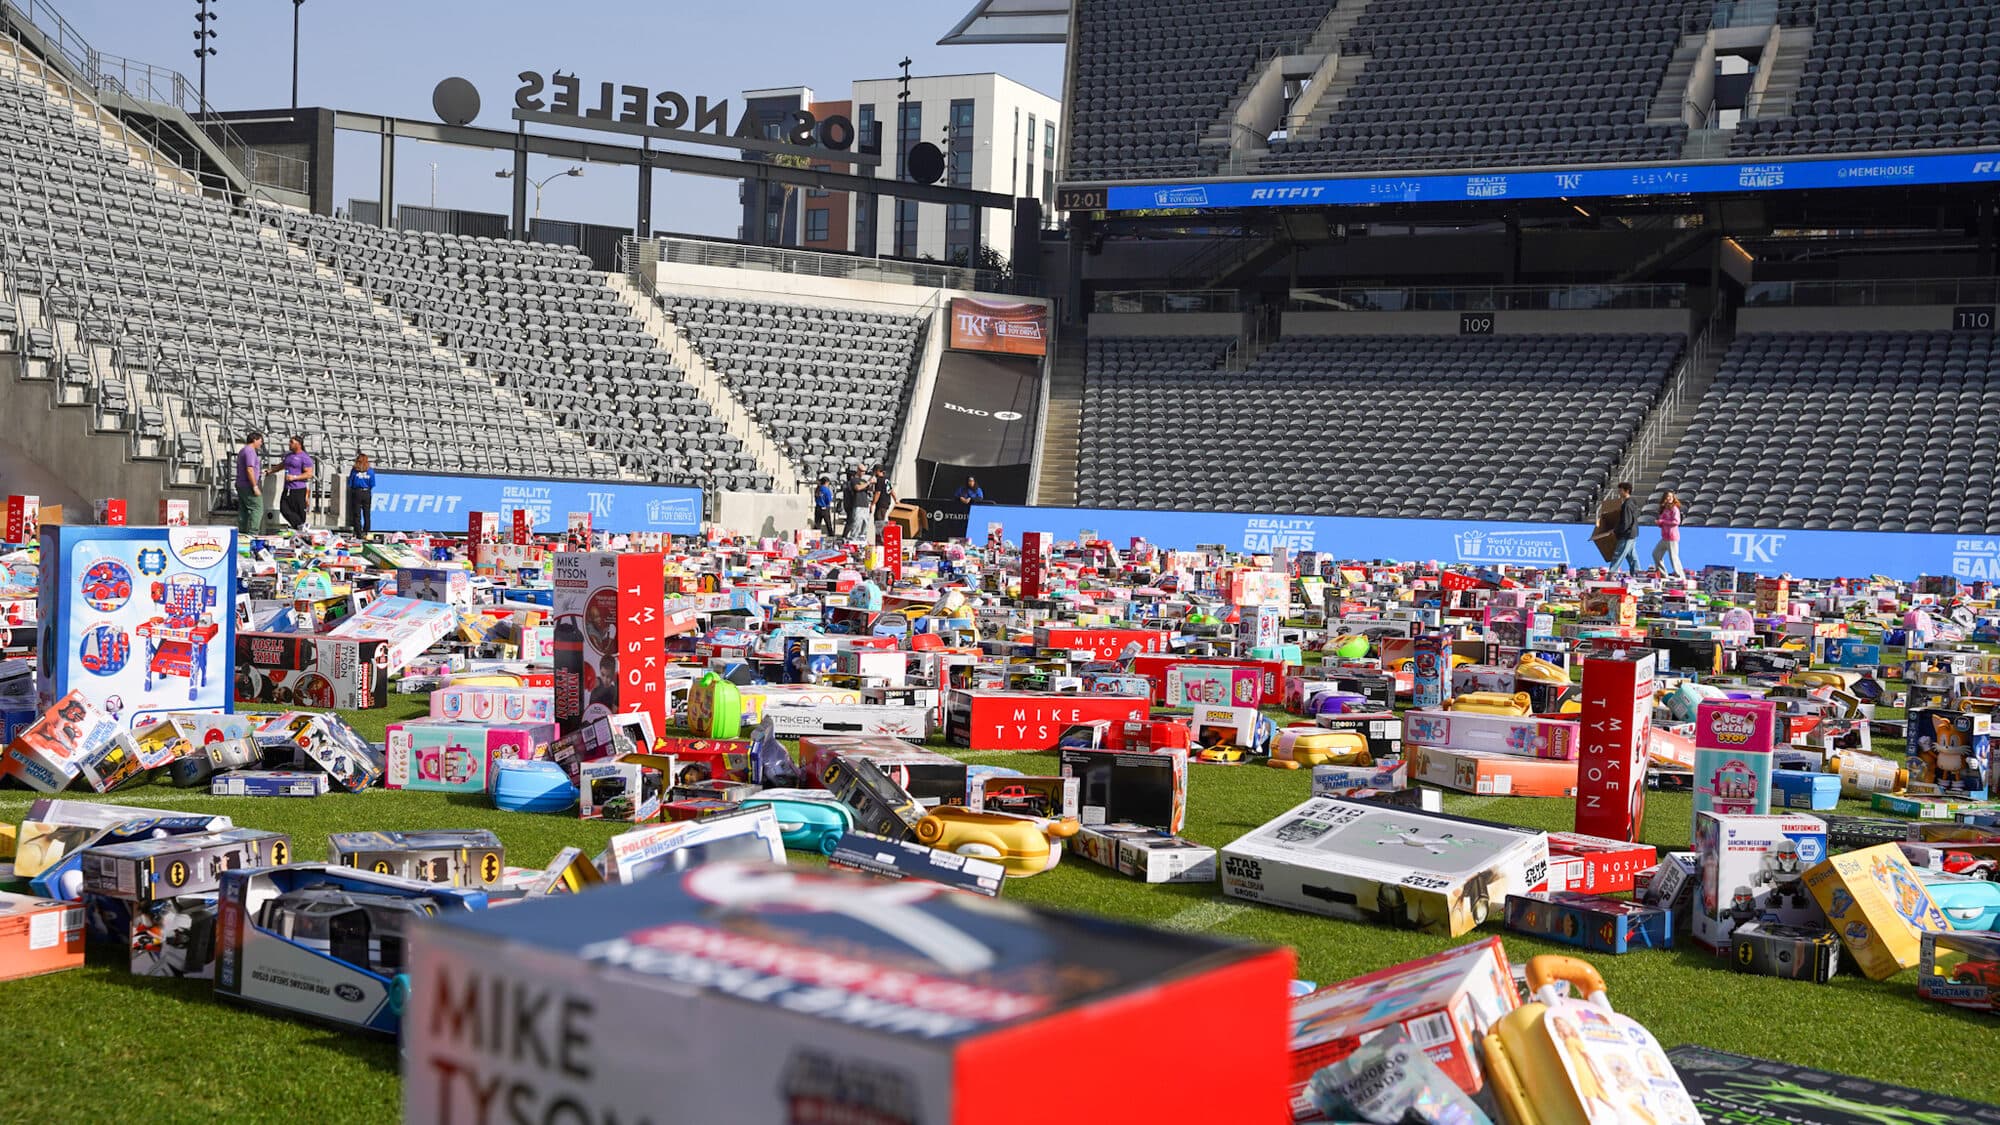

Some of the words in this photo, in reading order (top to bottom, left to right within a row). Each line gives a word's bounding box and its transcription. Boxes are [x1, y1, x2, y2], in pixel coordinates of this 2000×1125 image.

[1740, 165, 1783, 173] REALITY
[1849, 166, 1916, 177] MEMEHOUSE
[1467, 176, 1506, 184] REALITY
[1555, 174, 1583, 189] TKF
[1739, 175, 1784, 187] GAMES
[1252, 187, 1325, 199] RITFIT
[1467, 185, 1506, 196] GAMES
[1063, 192, 1101, 208] 12:01
[957, 314, 990, 336] TKF
[1463, 319, 1491, 332] 109
[1960, 313, 1990, 328] 110
[944, 402, 989, 417] BMO
[503, 486, 550, 499] REALITY
[371, 493, 462, 513] RITFIT
[588, 492, 616, 517] TKF
[661, 512, 673, 521] TOY
[674, 511, 693, 521] DRIVE
[1248, 519, 1314, 530] REALITY
[1244, 533, 1314, 553] GAMES
[1726, 533, 1787, 562] TKF
[1486, 545, 1516, 557] TOY
[1516, 546, 1562, 558] DRIVE
[557, 557, 580, 568] MIKE
[556, 569, 587, 579] TYSON
[251, 639, 285, 651] TYSON
[1075, 637, 1118, 647] MIKE
[628, 585, 642, 713] TYSON
[644, 607, 656, 692] MIKE
[341, 646, 349, 678] TYSON
[348, 645, 357, 670] MIKE
[1013, 709, 1081, 721] MIKE
[1207, 711, 1233, 719] SONIC
[995, 725, 1048, 739] TYS
[1713, 721, 1755, 735] CREAM
[1554, 727, 1562, 757] QUEEN
[1718, 733, 1747, 742] STOP
[1586, 698, 1606, 808] TYSON
[1606, 717, 1622, 790] MIKE
[1315, 773, 1348, 783] VENOM
[1323, 778, 1368, 790] TUMBLER
[1782, 824, 1820, 832] TRANSFORMERS
[622, 837, 657, 853] POLICE
[644, 834, 685, 858] PURSUIT
[1225, 857, 1262, 871] STAR
[1603, 859, 1648, 872] TYSON
[1225, 865, 1262, 880] WARS
[1525, 867, 1547, 887] STAR
[1610, 873, 1631, 883] IKE
[1234, 888, 1258, 898] GROGU
[290, 981, 316, 992] MUSTANG
[1921, 978, 1943, 987] FORD
[316, 986, 330, 995] FORD
[1932, 988, 1970, 997] MUSTANG
[429, 962, 596, 1083] MIKE
